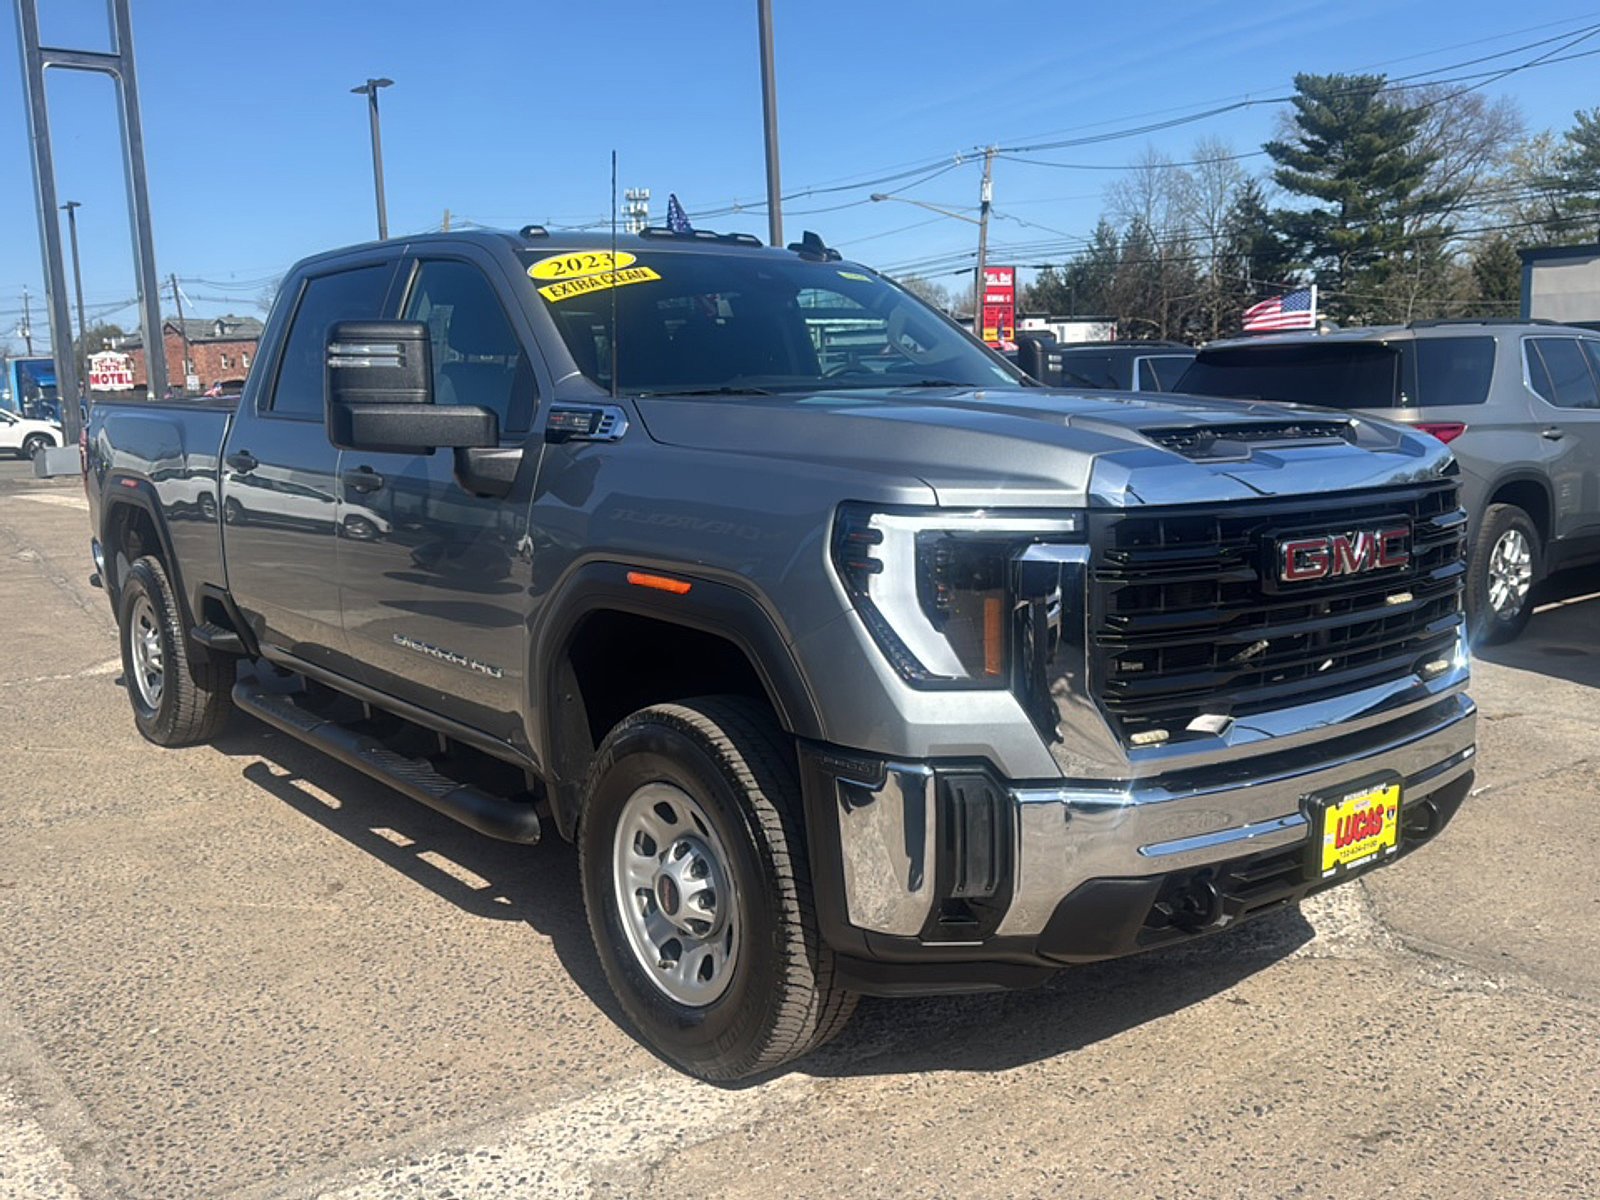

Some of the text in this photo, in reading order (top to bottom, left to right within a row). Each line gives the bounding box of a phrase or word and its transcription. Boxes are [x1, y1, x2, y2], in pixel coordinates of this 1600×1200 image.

[549, 253, 616, 276] 2023
[549, 277, 602, 297] EXTRA
[89, 373, 134, 384] MOTEL
[1280, 528, 1410, 582] GMC
[1335, 803, 1385, 850] LUCAS
